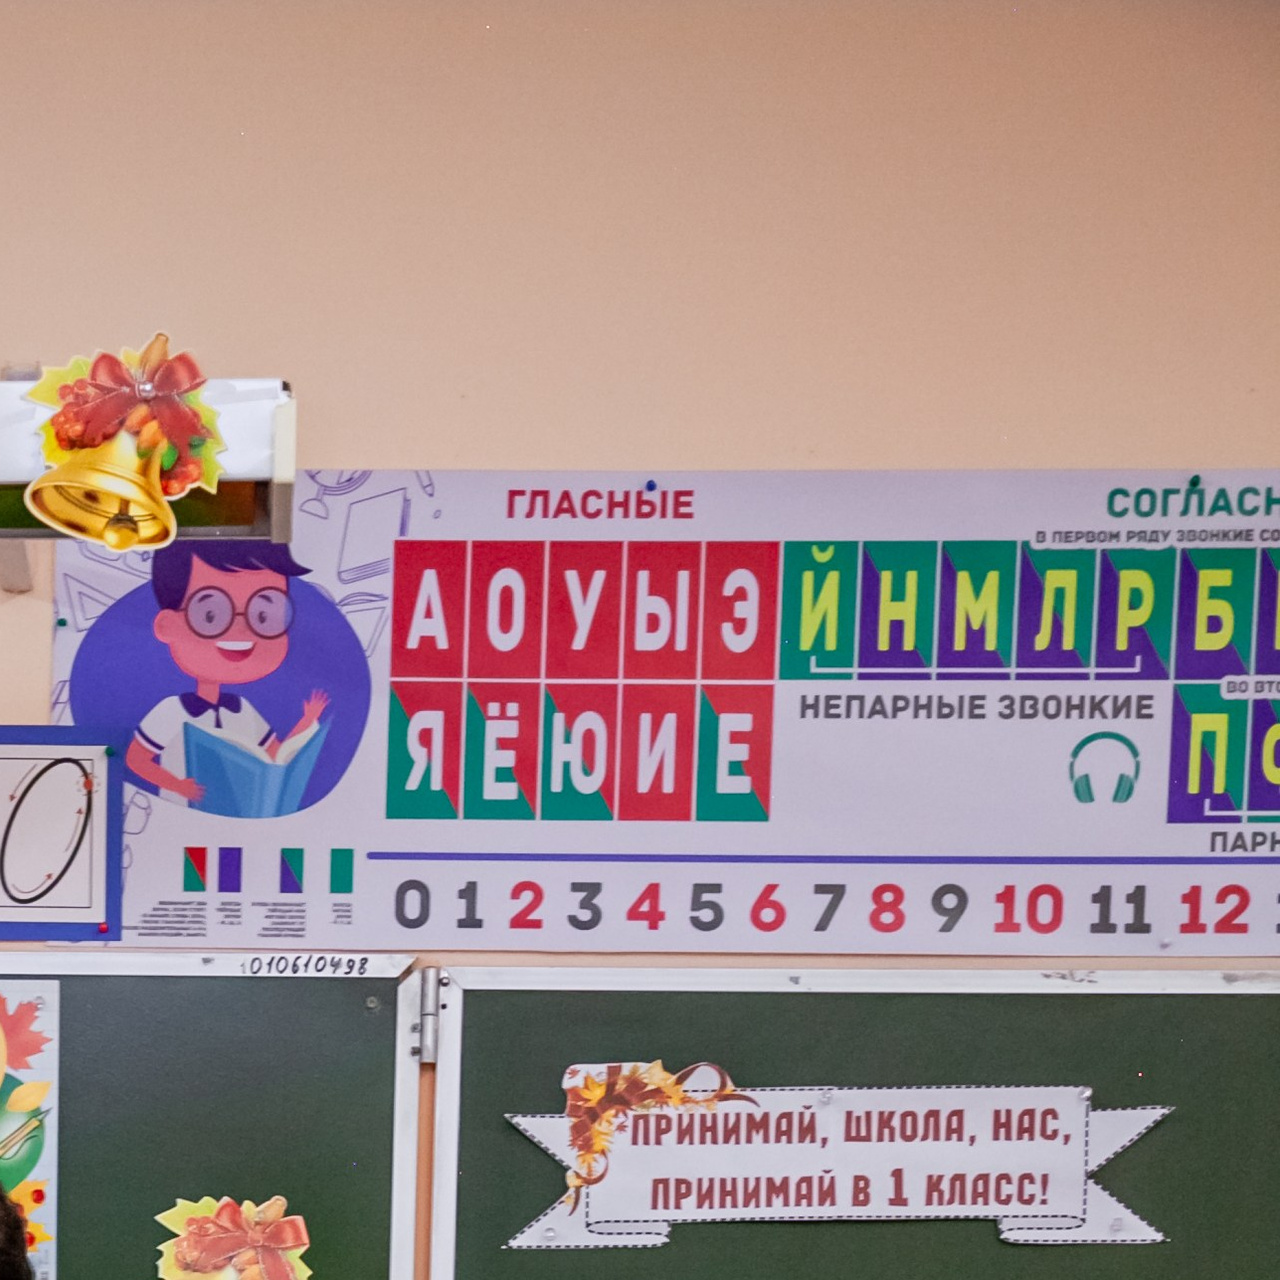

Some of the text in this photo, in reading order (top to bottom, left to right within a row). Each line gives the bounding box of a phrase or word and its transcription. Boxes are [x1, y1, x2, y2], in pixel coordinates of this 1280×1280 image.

[506, 488, 695, 521] ГЛАСНЫЕ
[1035, 531, 1047, 543] В
[1052, 531, 1121, 543] ПЕРВОМ
[1126, 530, 1171, 543] РЯДУ
[1176, 529, 1254, 542] ЗВОНКИЕ
[799, 694, 1155, 720] НЕПАРНЫЕ ЗВОНКИЕ
[394, 880, 431, 935] 0
[455, 880, 485, 935] 1
[509, 880, 545, 935] 2
[567, 880, 603, 935] 3
[626, 880, 666, 935] 4
[689, 880, 725, 935] 5
[750, 880, 787, 935] 6
[813, 880, 847, 935] 7
[869, 880, 906, 935] 8
[931, 880, 969, 935] 9
[993, 880, 1064, 935] 10
[1089, 880, 1152, 935] 11
[1179, 880, 1252, 935] 12
[630, 1105, 1072, 1149] ПРИНИМАЙ, ШКОЛА, НАС,
[650, 1168, 1050, 1211] ПРИНИМАЙ В 1 КЛАСС!
